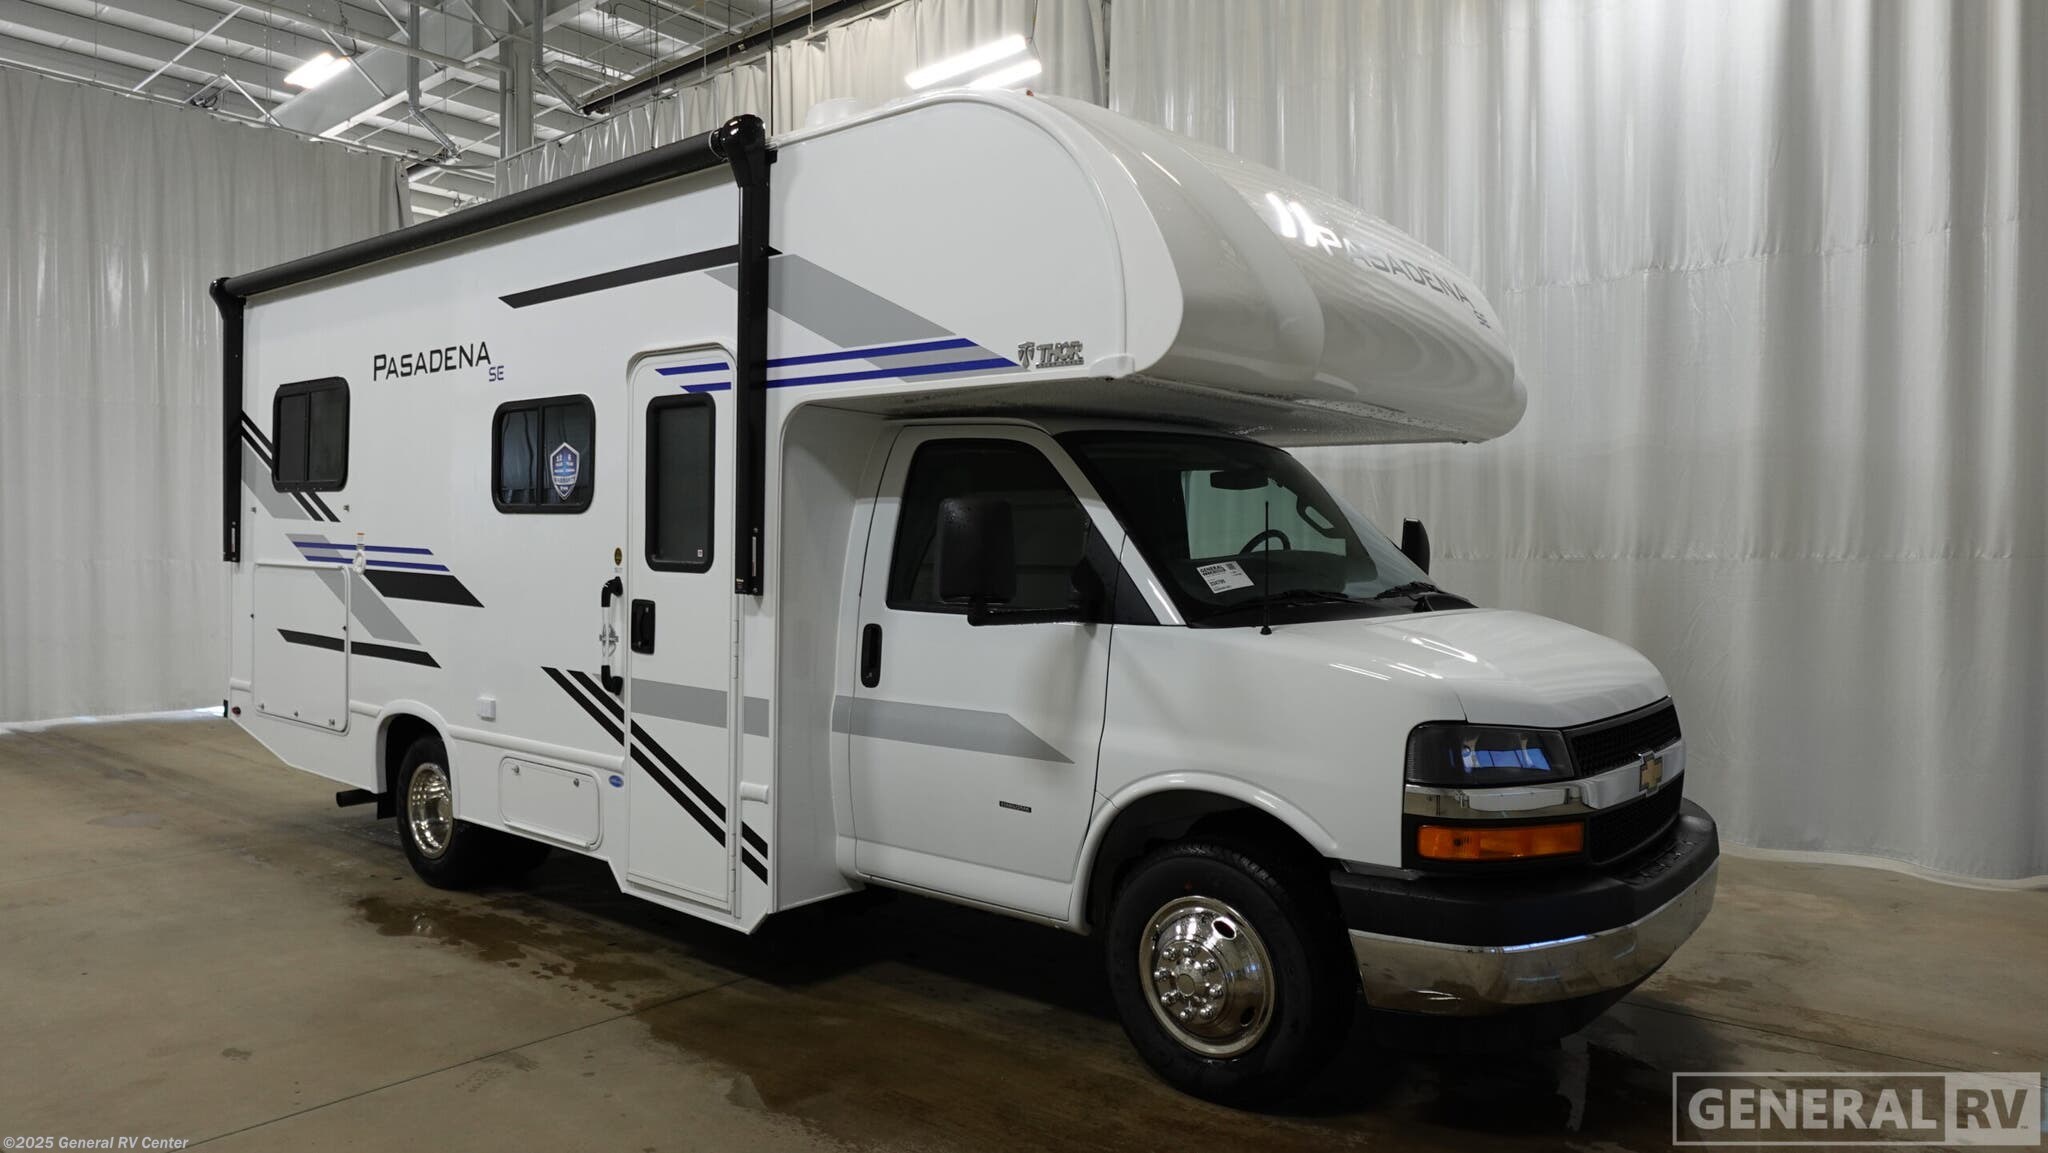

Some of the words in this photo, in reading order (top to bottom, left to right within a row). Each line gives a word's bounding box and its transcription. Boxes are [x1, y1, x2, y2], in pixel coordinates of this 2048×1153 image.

[373, 341, 491, 381] PASADENA
[488, 365, 505, 382] SE
[1036, 341, 1083, 363] THOR
